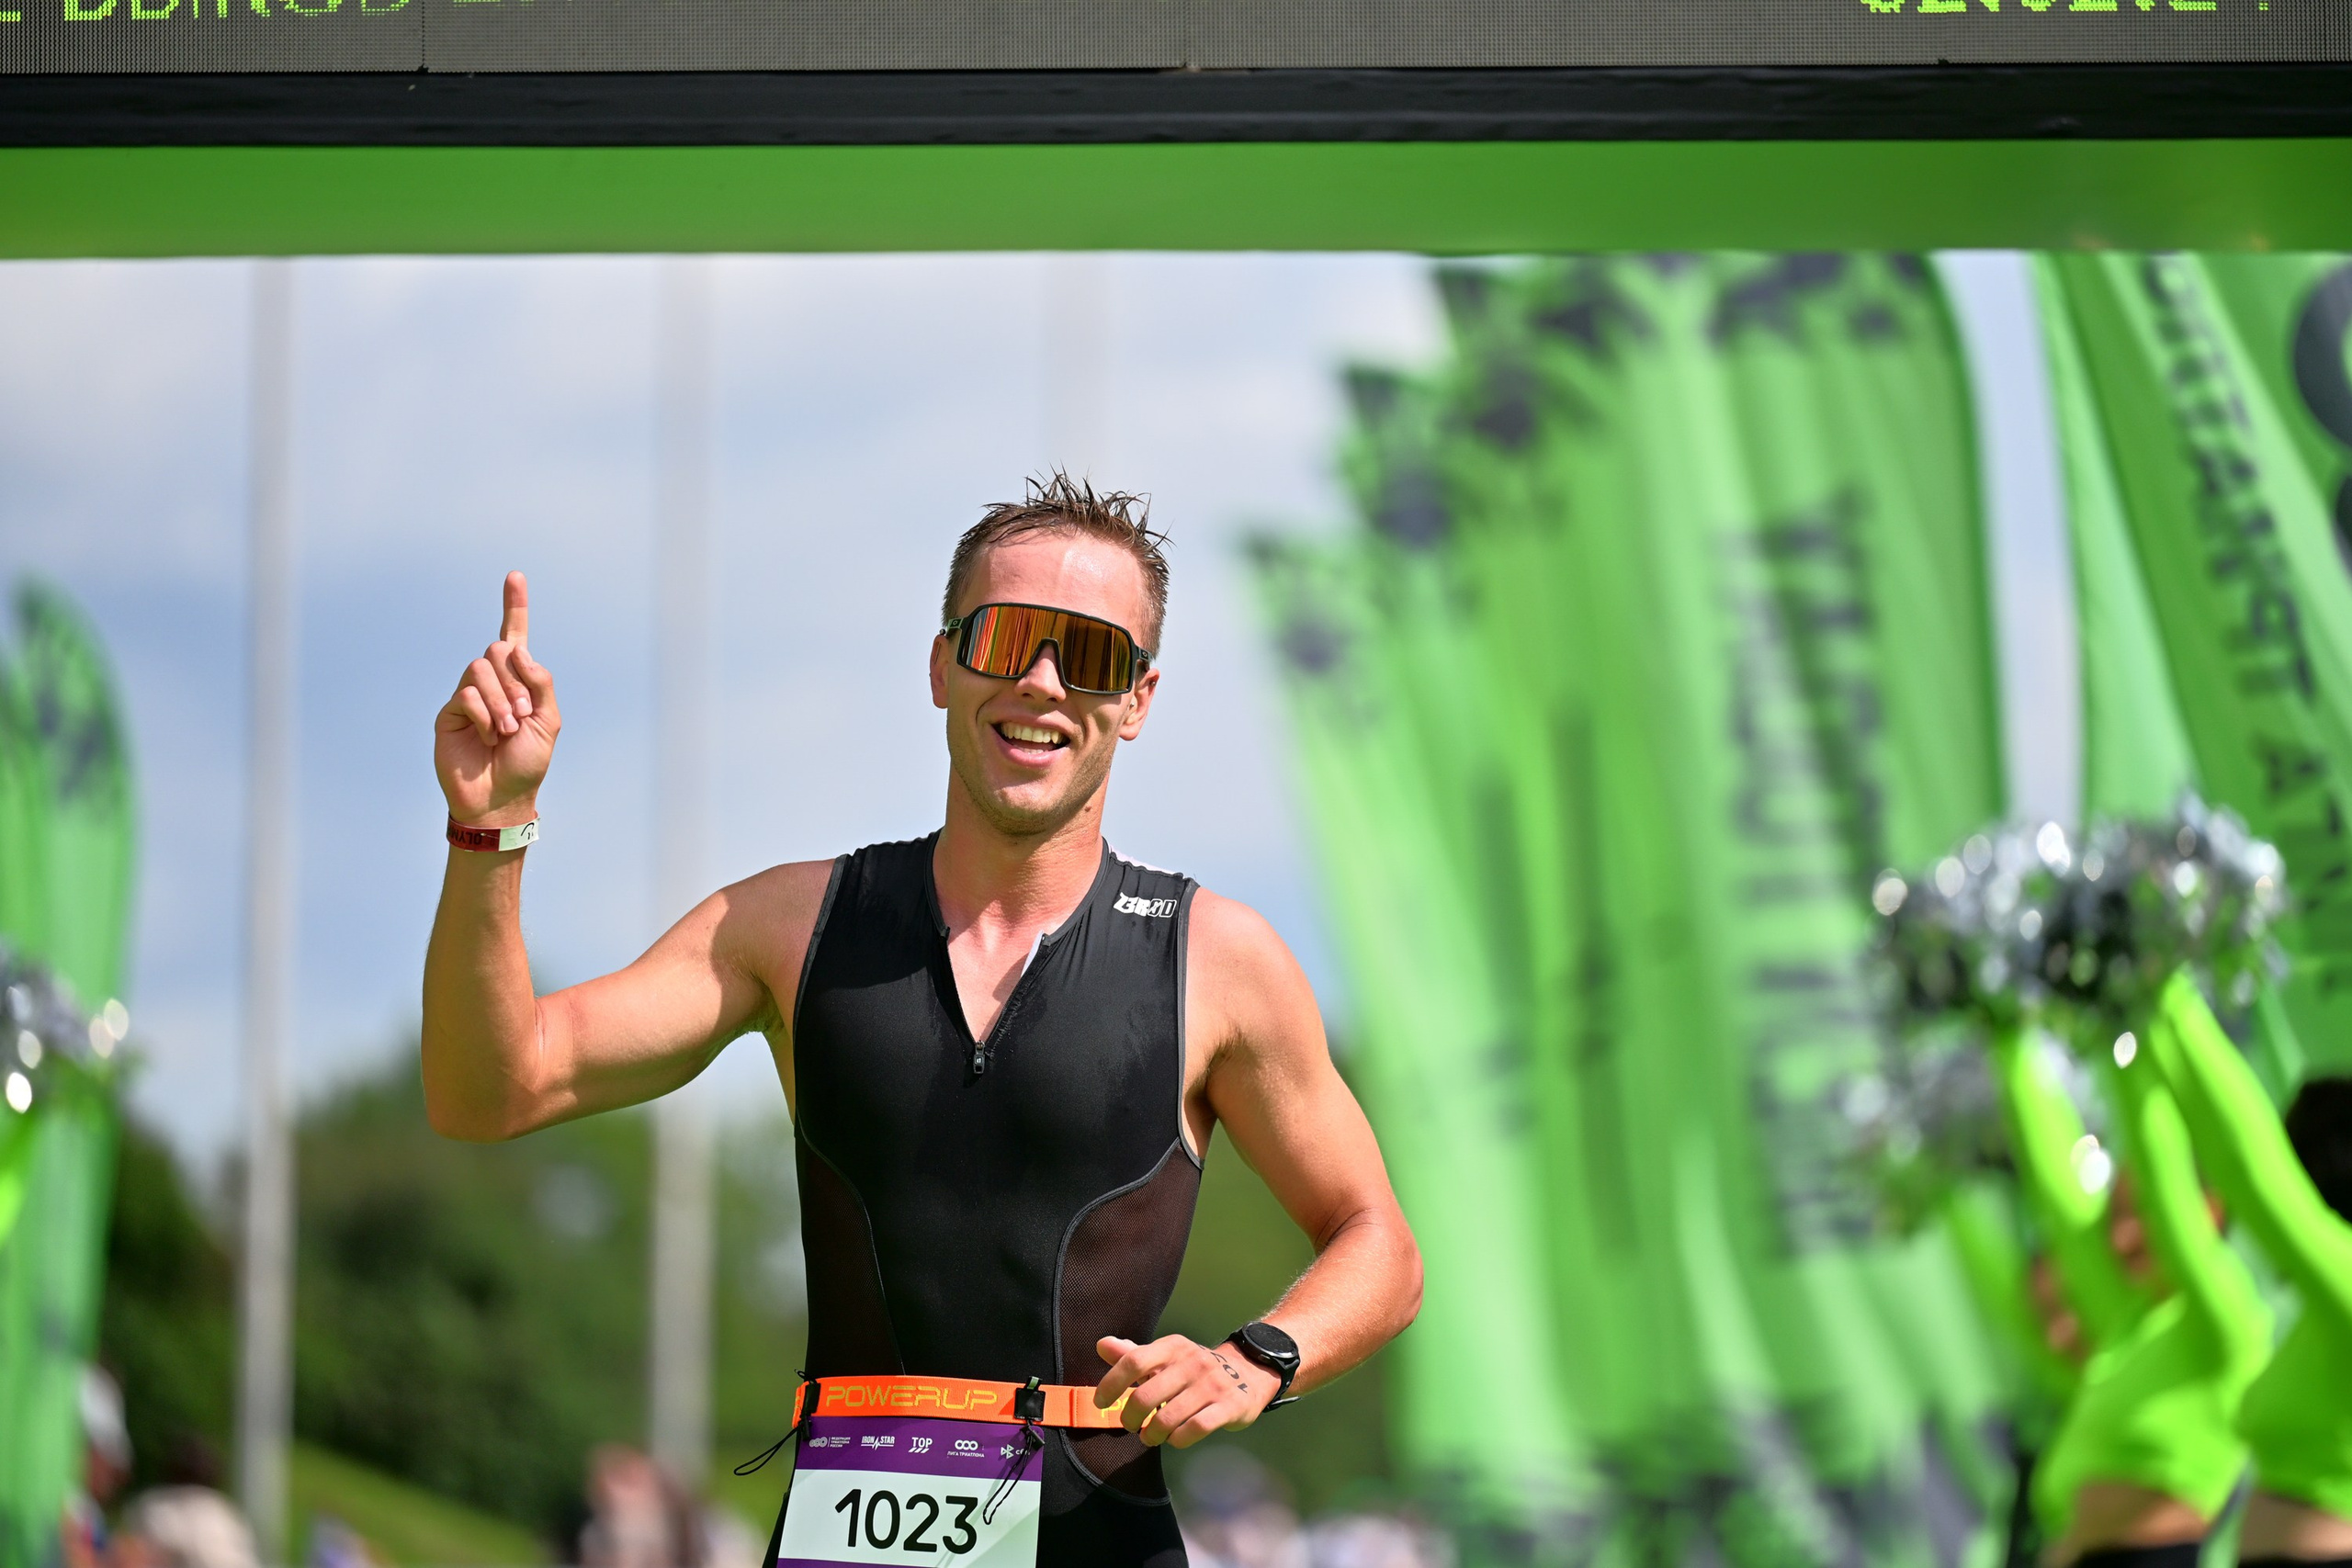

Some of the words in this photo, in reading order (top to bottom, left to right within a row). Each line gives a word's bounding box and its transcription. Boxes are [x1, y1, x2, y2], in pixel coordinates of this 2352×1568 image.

[826, 1385, 998, 1411] POWERUP
[880, 1436, 895, 1444] STAR
[911, 1437, 933, 1448] TOP
[834, 1488, 978, 1554] 1023
